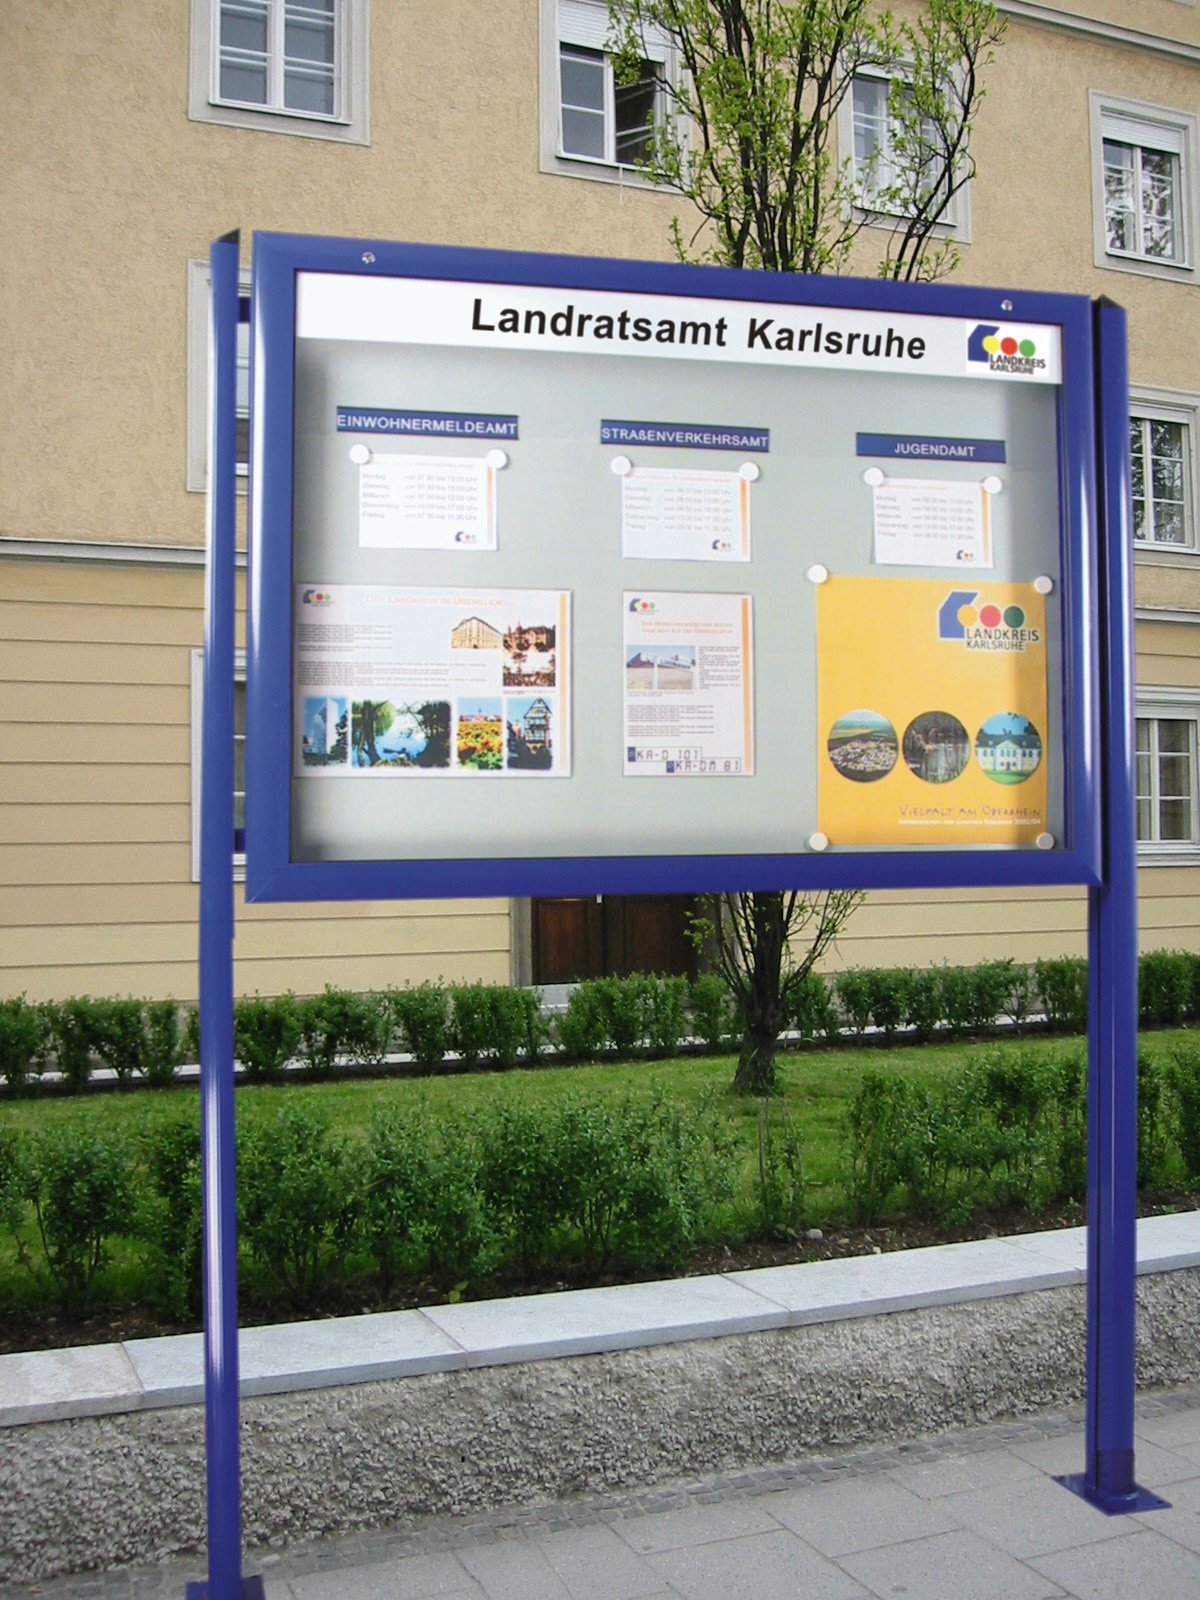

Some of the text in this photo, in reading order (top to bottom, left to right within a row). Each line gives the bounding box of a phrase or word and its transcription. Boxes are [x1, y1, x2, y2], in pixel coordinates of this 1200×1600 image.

[471, 298, 926, 360] Landratsamt Karlsruhe
[990, 354, 1046, 369] LANDKREIS
[990, 364, 1034, 375] KARLSRUHE
[337, 414, 517, 435] EINWOHNERMELDEAMT
[601, 427, 769, 448] STRAßENVERKEHRSAMT
[894, 443, 976, 457] JUGENDAMT
[966, 628, 1040, 642] LANDKREIS
[966, 640, 1024, 650] KARLSRUHE
[678, 750, 698, 760] 101
[959, 808, 977, 816] AM
[982, 805, 1041, 816] OBERRHEIN
